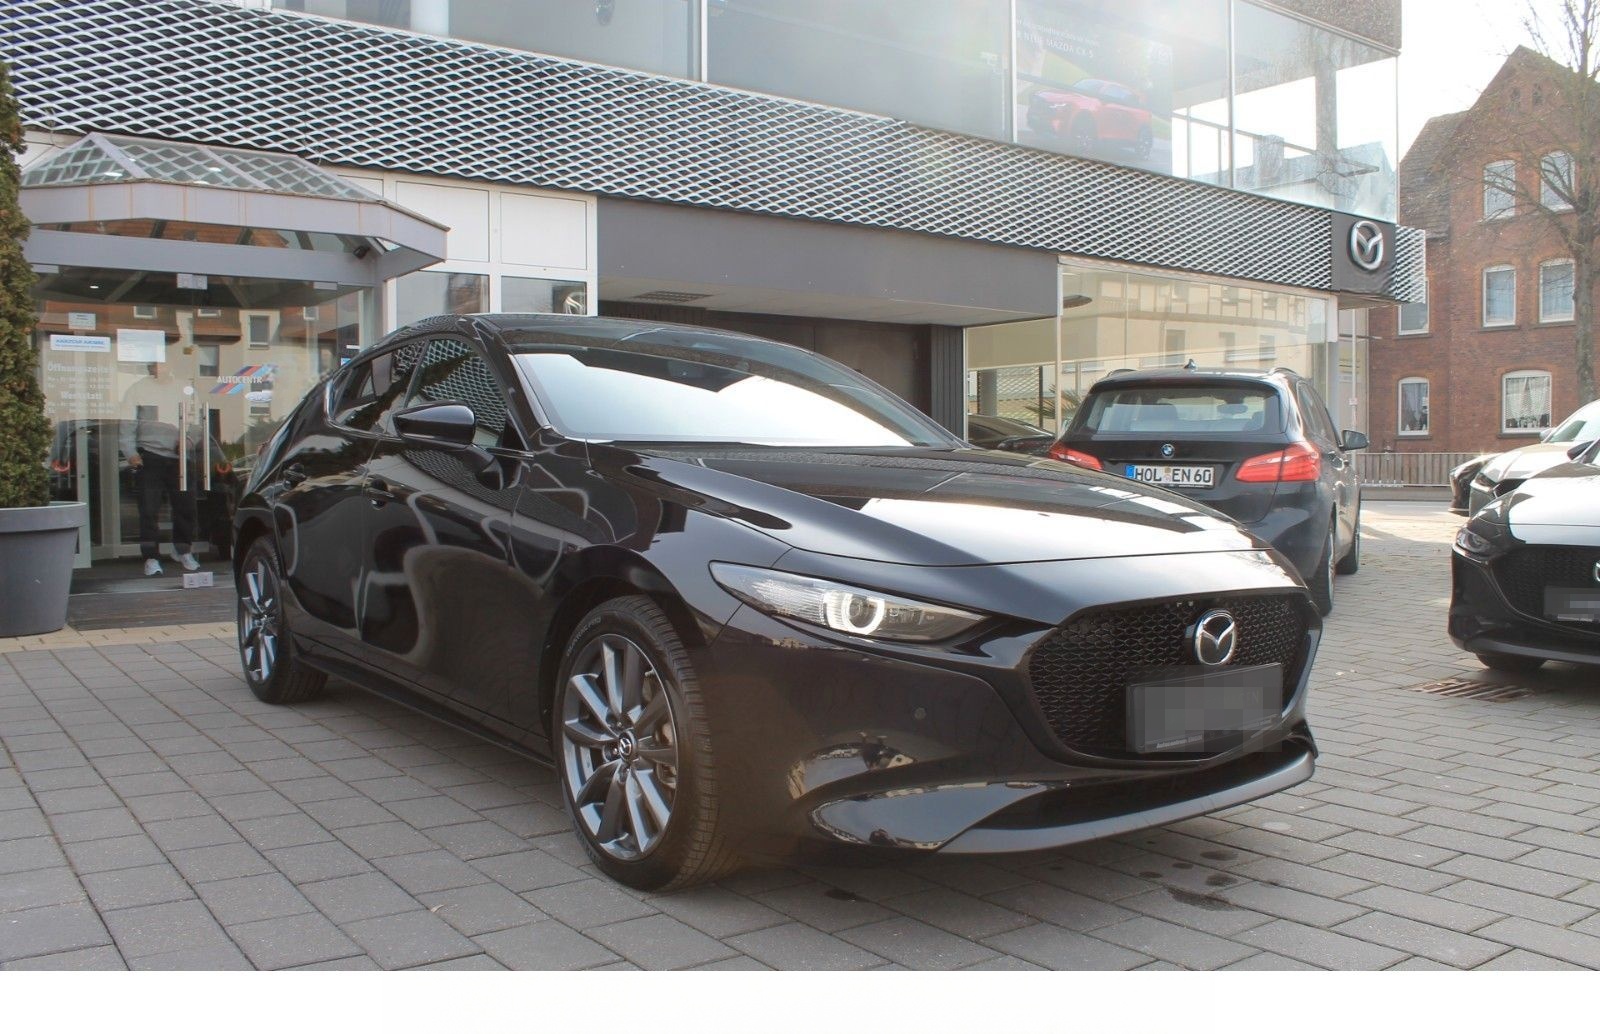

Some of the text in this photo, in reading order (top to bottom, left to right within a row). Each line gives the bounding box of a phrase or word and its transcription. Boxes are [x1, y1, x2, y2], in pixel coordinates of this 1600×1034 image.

[1046, 38, 1074, 54] MAZDA
[1134, 468, 1212, 483] HOL EN 60
